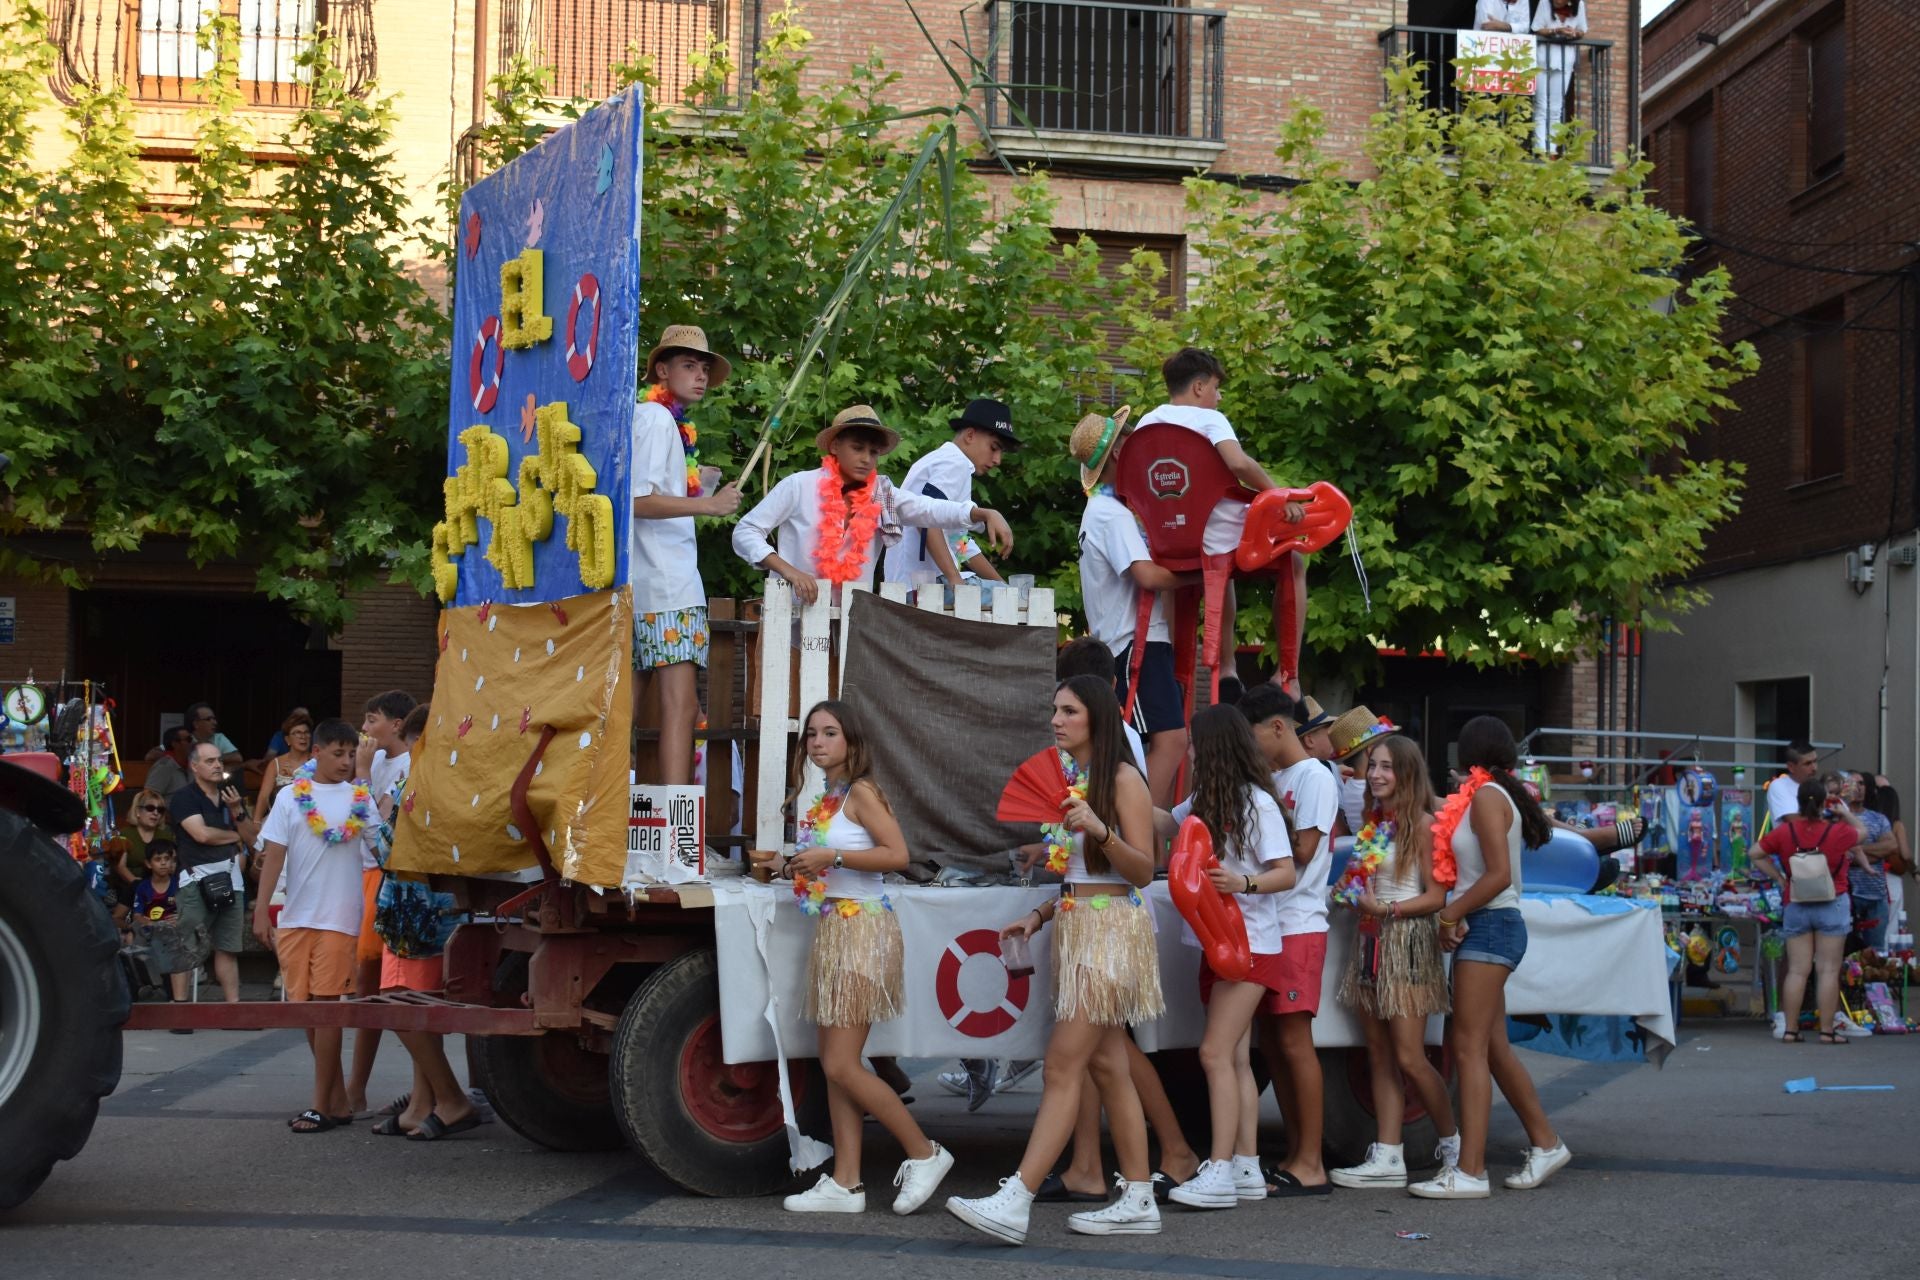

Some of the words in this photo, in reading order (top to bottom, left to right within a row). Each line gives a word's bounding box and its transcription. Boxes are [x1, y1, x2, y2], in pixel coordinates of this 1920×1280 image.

[500, 247, 552, 351] EL
[1154, 471, 1181, 481] Estrella
[668, 794, 695, 827] viña
